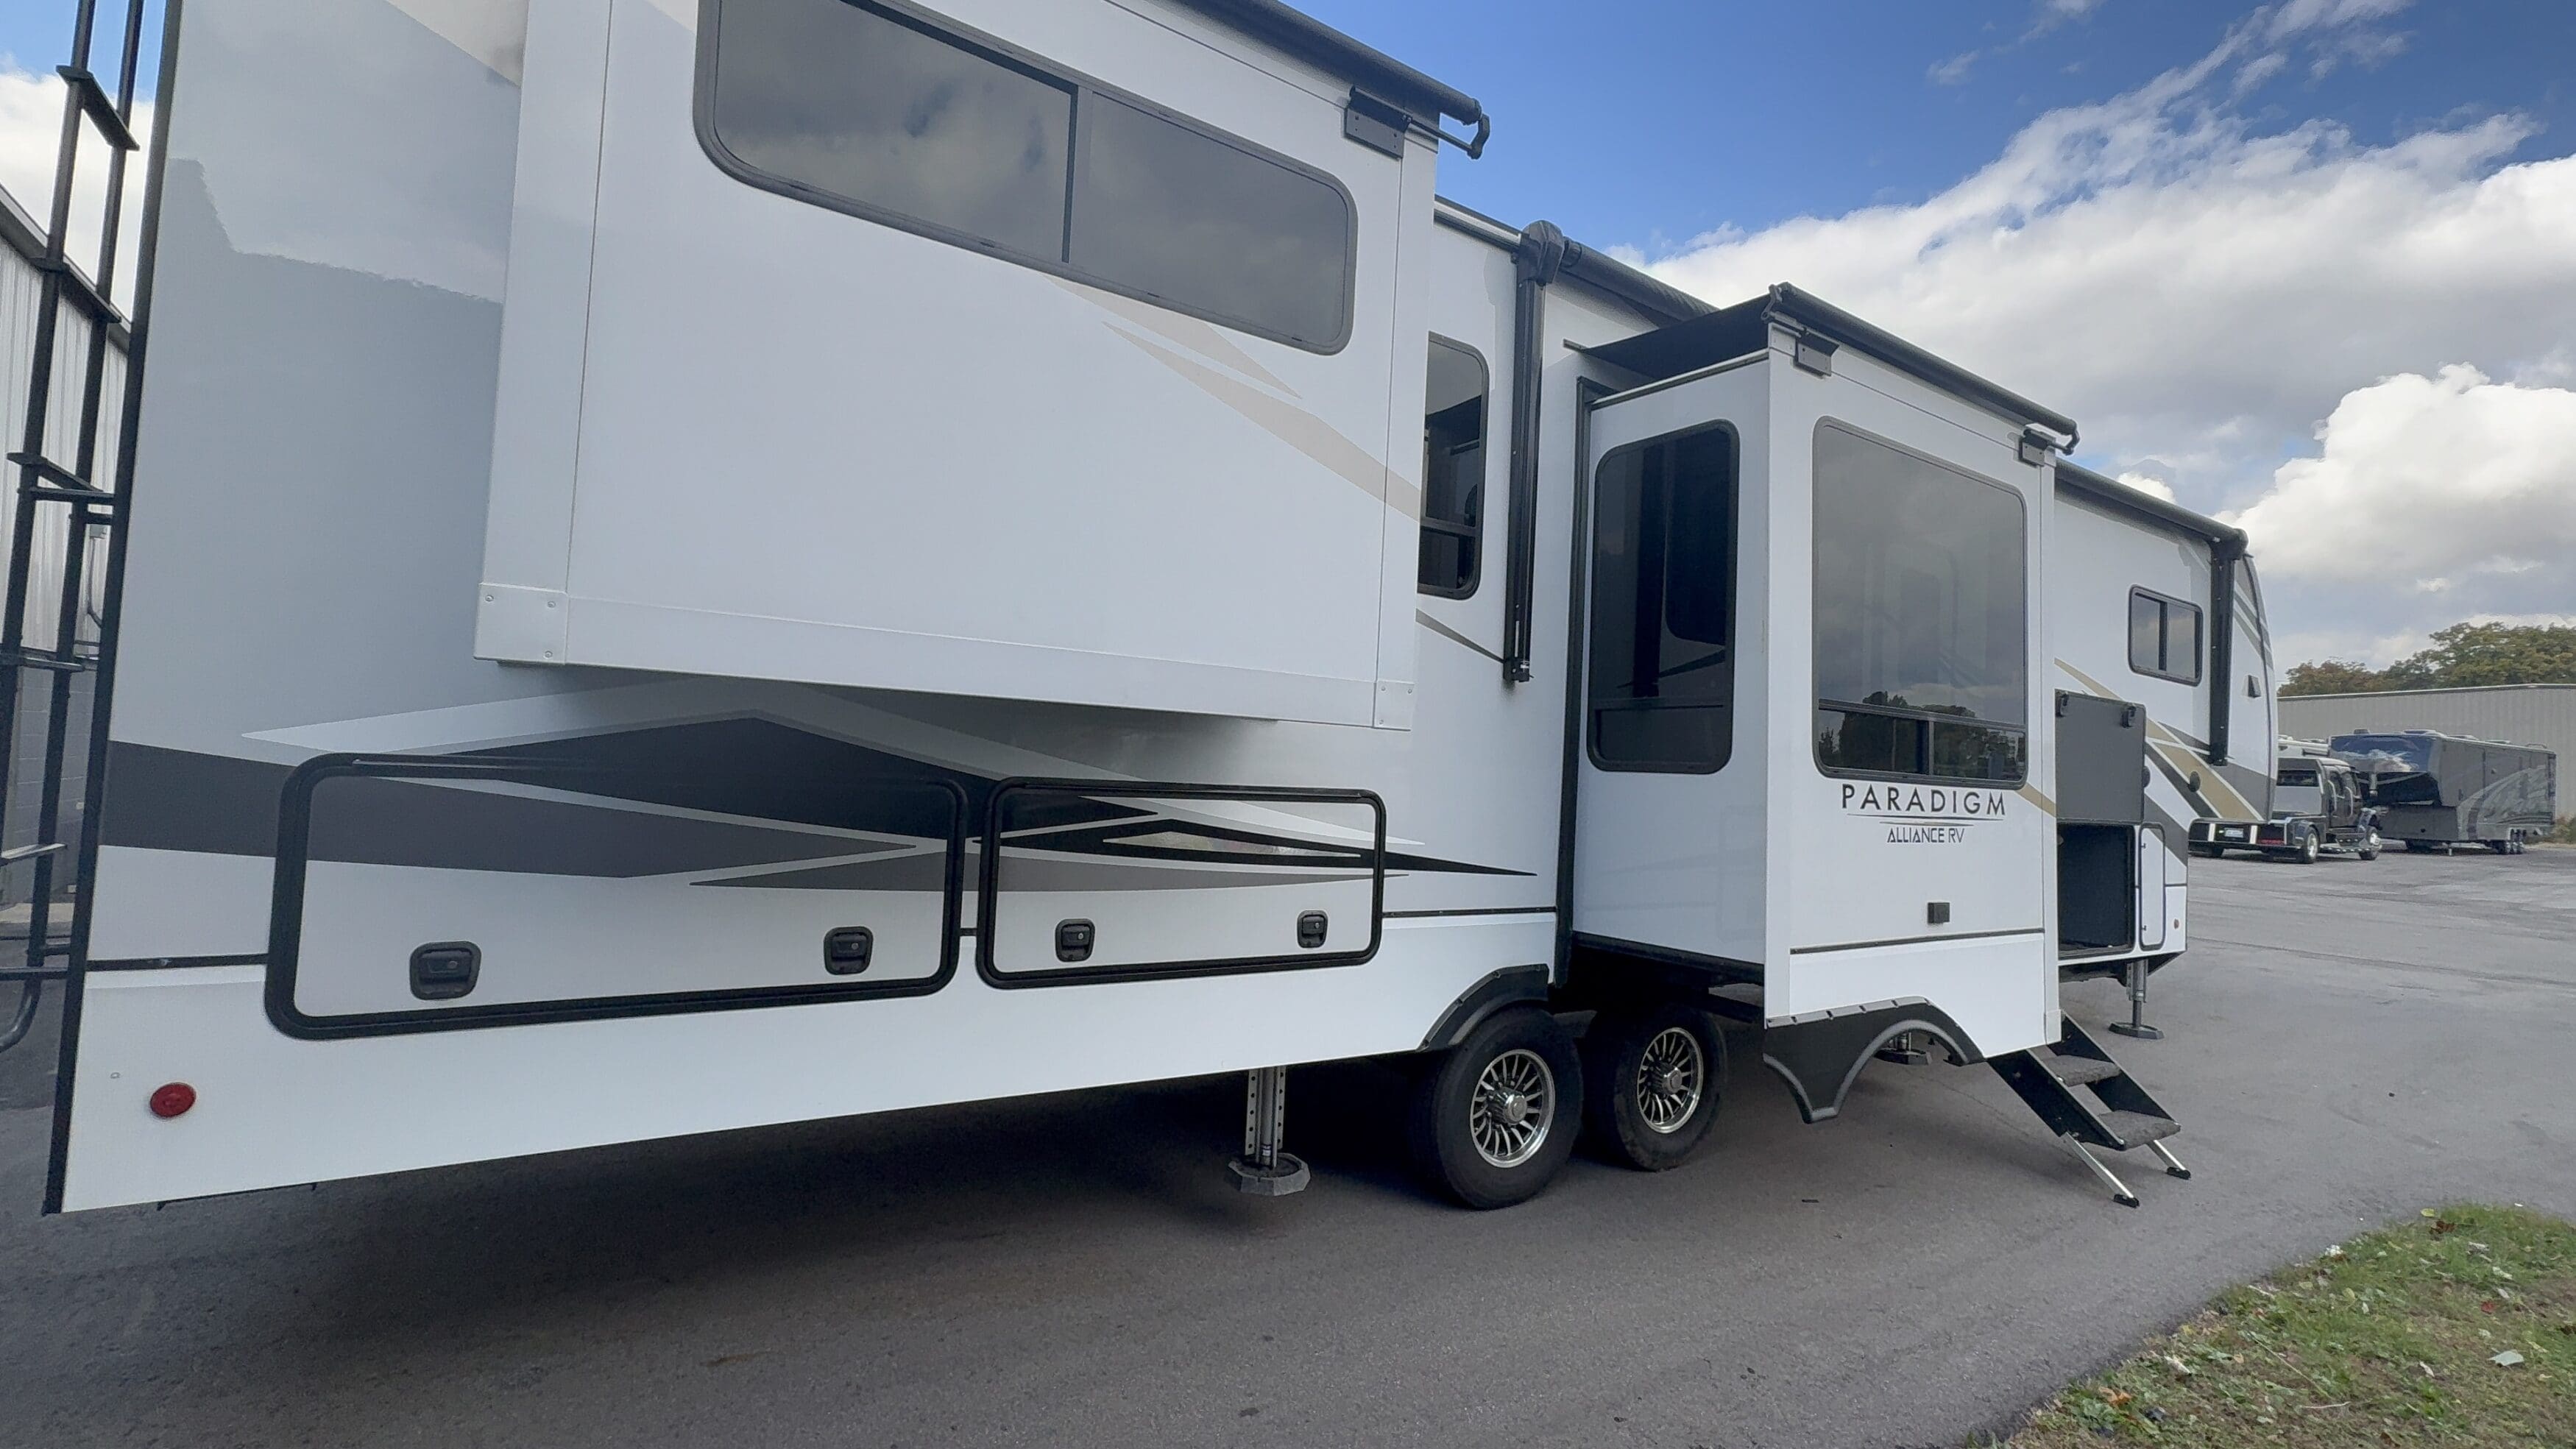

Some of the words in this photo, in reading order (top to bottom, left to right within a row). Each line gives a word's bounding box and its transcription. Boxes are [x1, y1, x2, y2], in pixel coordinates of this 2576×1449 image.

[1842, 783, 2006, 815] PARADIGM
[1886, 827, 1945, 843] ALLIANCE
[1948, 828, 1965, 843] RV
